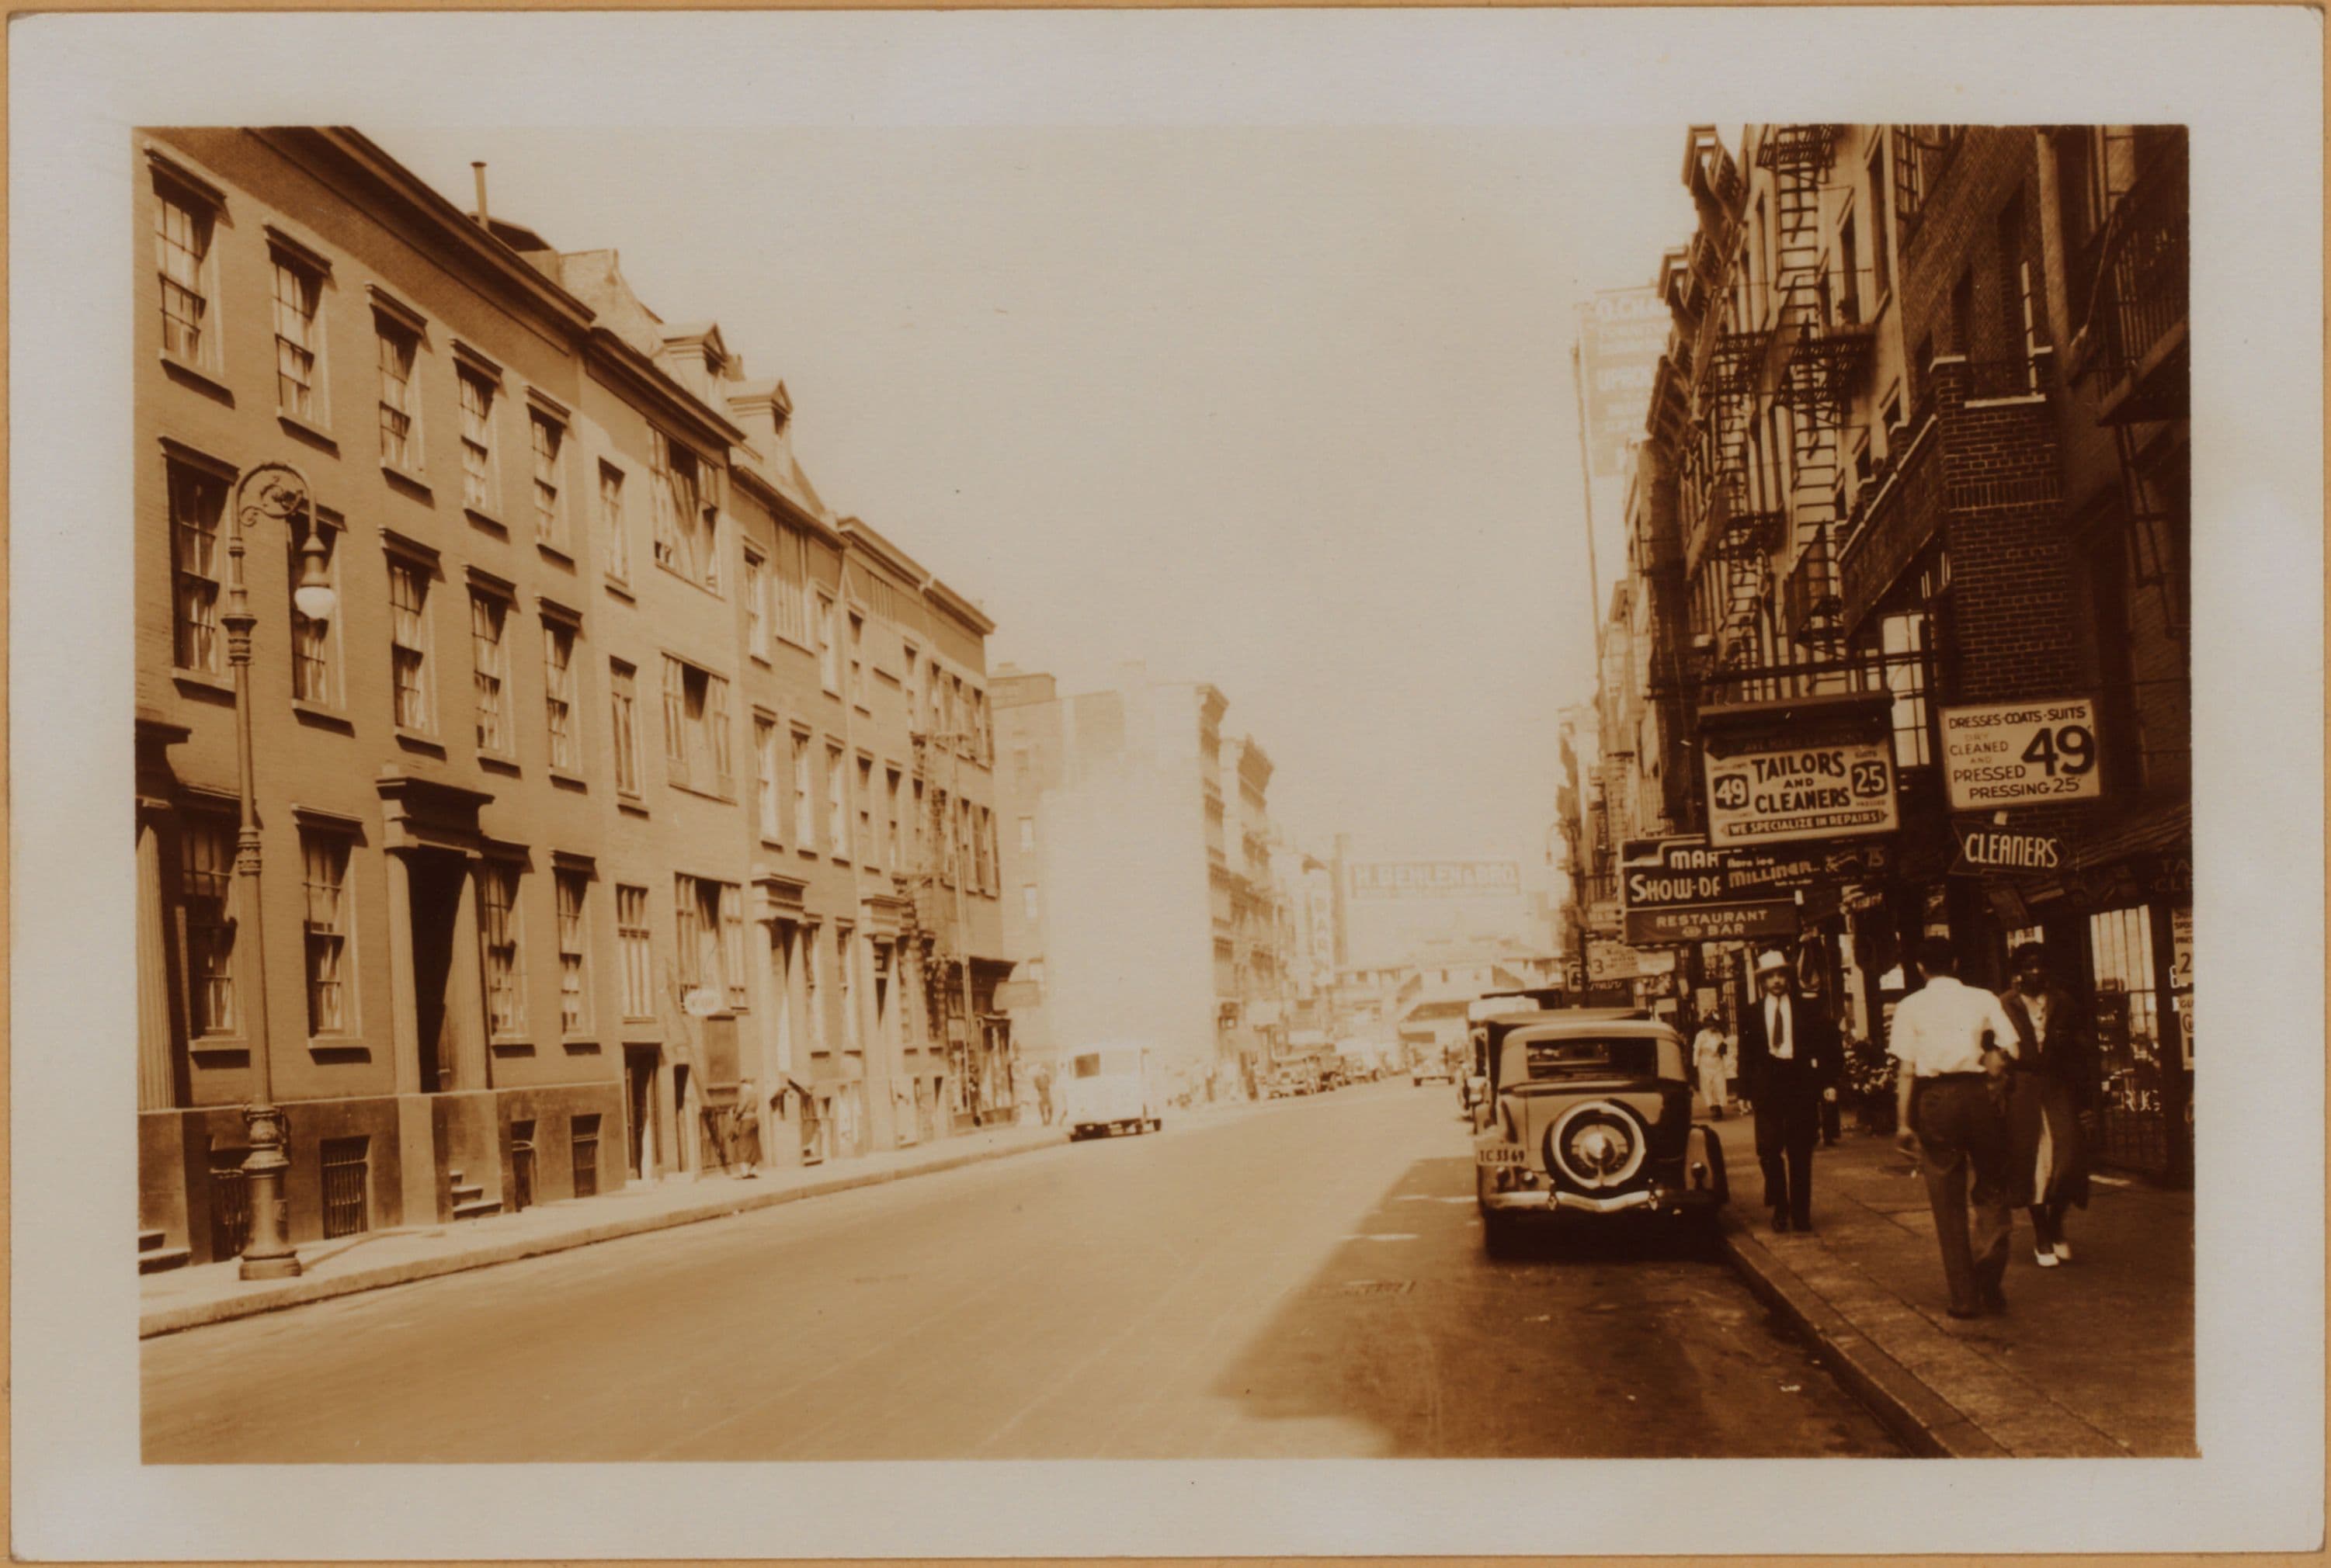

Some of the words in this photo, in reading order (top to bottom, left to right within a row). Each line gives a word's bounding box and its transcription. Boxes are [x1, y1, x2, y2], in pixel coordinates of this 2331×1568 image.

[2047, 706, 2086, 721] SUITS
[1950, 741, 2008, 756] CLEANED
[1751, 751, 1846, 784] TAILORS
[1954, 765, 2026, 782] PRESSED
[1784, 778, 1814, 789] AND
[1853, 765, 1885, 793] 25
[1715, 778, 1746, 805] 49
[1969, 782, 2050, 800] PRESSING
[1755, 788, 1850, 814] CLEANERS
[1731, 823, 1746, 834] WE
[1749, 816, 1811, 831] SPECIALIZE
[1815, 814, 1826, 825] IN
[1829, 810, 1876, 824] REPAIRS
[1965, 833, 2058, 868] CLEANERS
[1655, 911, 1767, 928] RESTAURANT
[1707, 924, 1744, 935] BAR
